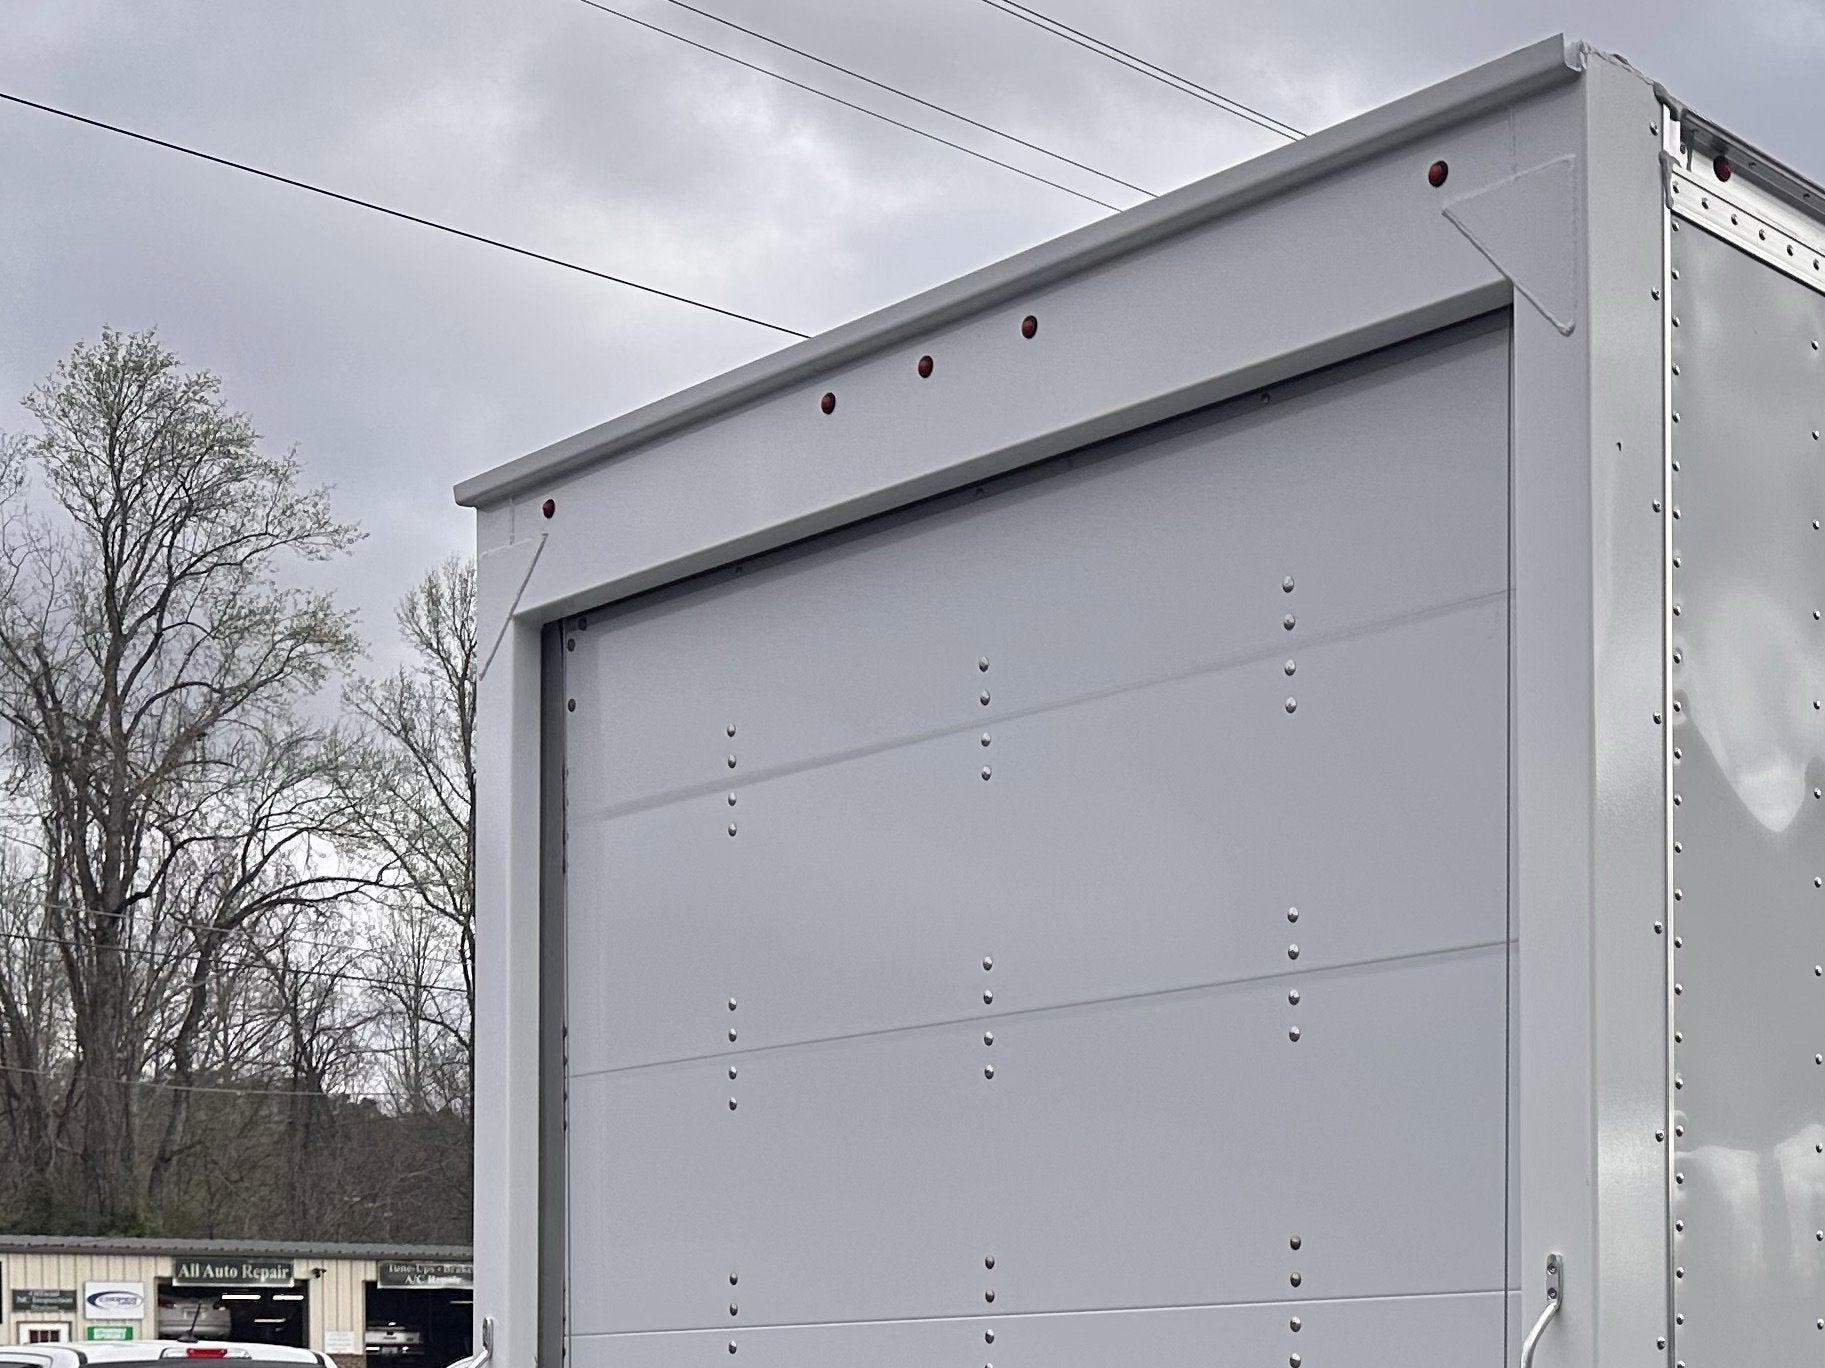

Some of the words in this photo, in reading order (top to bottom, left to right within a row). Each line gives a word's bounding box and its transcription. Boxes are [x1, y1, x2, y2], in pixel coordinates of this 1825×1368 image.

[178, 1264, 200, 1279] All
[203, 1265, 238, 1279] Auto
[241, 1265, 289, 1281] Repair
[405, 1274, 425, 1285] A/C
